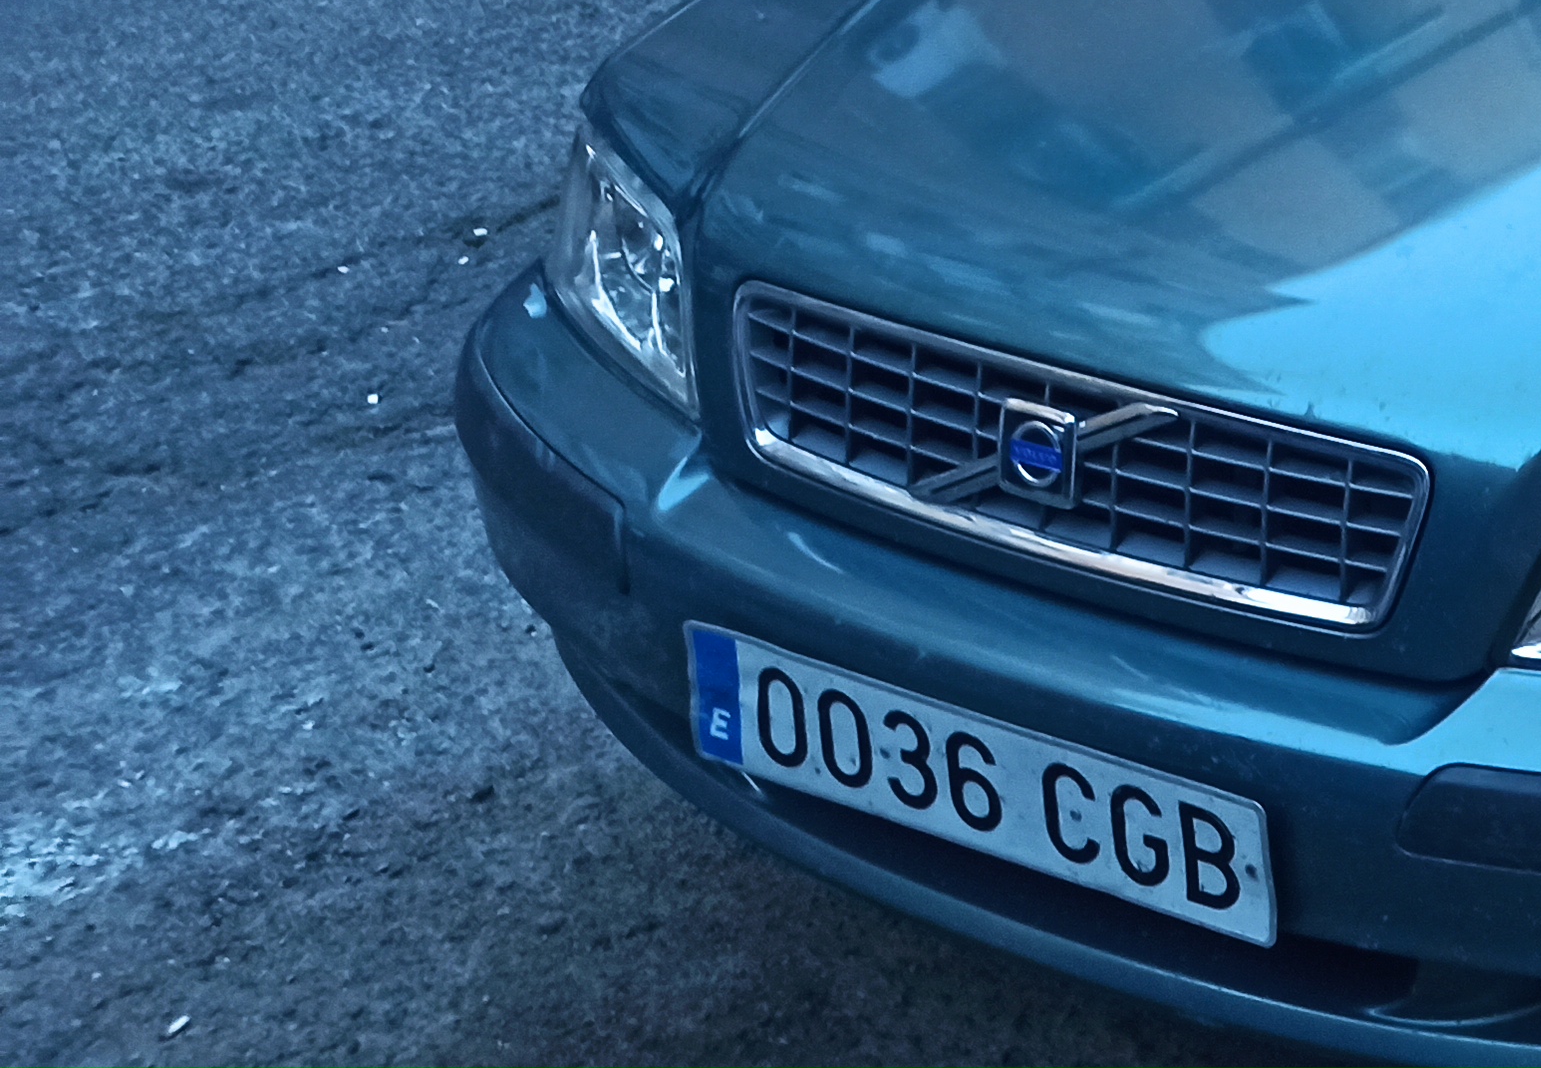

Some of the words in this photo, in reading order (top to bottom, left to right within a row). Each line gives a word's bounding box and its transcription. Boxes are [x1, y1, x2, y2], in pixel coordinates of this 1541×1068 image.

[709, 706, 732, 741] E
[757, 666, 1003, 833] 0036
[1041, 761, 1241, 910] CGB
